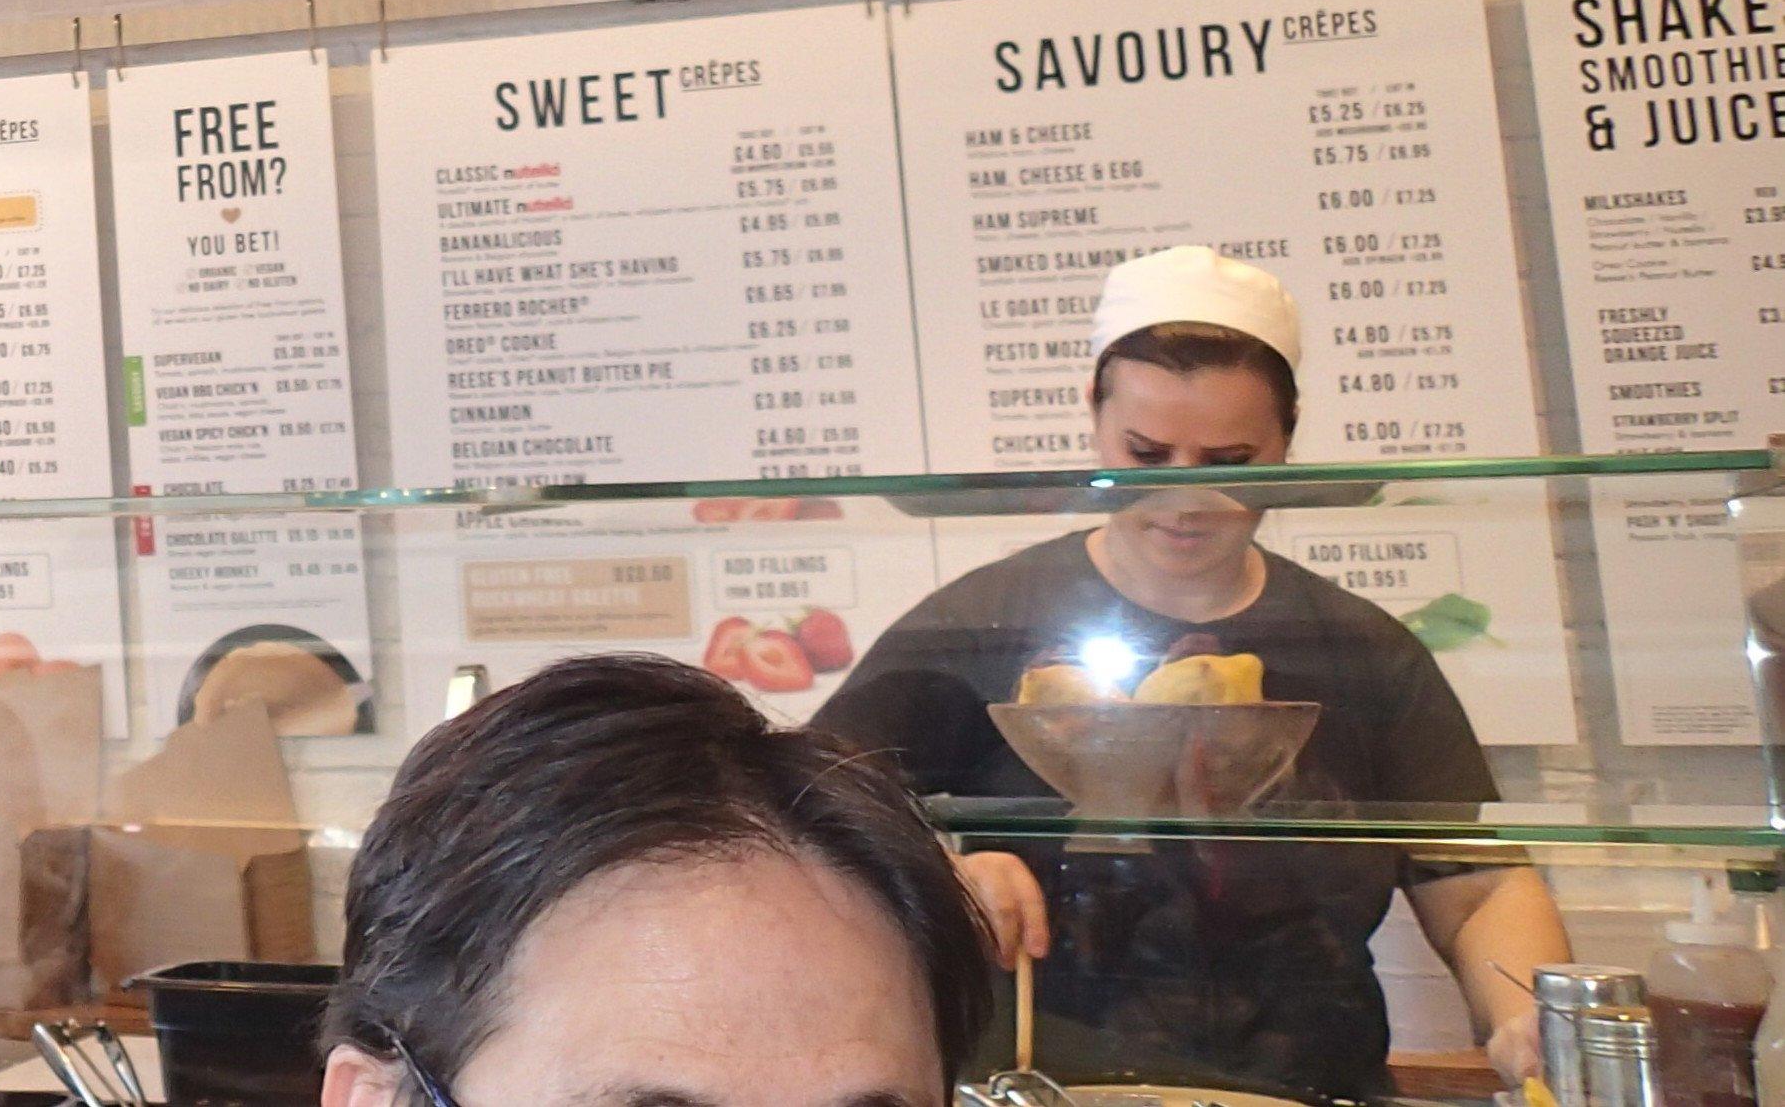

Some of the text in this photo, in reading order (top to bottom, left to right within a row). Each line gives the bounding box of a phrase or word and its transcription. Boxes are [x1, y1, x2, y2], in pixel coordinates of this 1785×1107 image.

[994, 8, 1378, 94] SAVOURY CRÊPES
[495, 60, 761, 132] SWEET CRÊPES
[1309, 102, 1364, 123] £5.25
[174, 100, 279, 158] FREE
[966, 129, 1002, 147] HAM
[1026, 122, 1093, 144] CHEESE
[1585, 104, 1616, 152] &
[1314, 144, 1369, 166] £5.75
[177, 157, 287, 203] FROM?
[436, 165, 498, 184] CLASSIC
[1019, 164, 1085, 185] CHEESE
[1109, 159, 1144, 180] EGG
[438, 199, 511, 219] ULTIMATE
[1319, 189, 1374, 210] £6.00
[1584, 190, 1687, 211] MILKSHAKES
[973, 207, 1100, 230] HAM SUPREME
[188, 231, 279, 256] YOU BET!
[440, 229, 562, 253] BANANALICIOUS
[1220, 239, 1291, 258] CHEESE
[1323, 233, 1379, 255] £6.00
[475, 267, 514, 285] HAVE
[520, 263, 563, 282] WHAT
[569, 260, 614, 280] SHE'S
[619, 257, 679, 275] HAVING
[977, 248, 1126, 274] SMOKED SALMON
[1329, 280, 1385, 300] £6.00
[444, 301, 511, 321] FERRERO
[980, 297, 1049, 319] LE GOAT
[1598, 306, 1668, 324] FRESHLY
[501, 334, 556, 352] COOKIE
[985, 342, 1040, 361] PESTO
[154, 351, 222, 367] SUPERVEGAN
[1604, 345, 1668, 364] ORANGE
[448, 371, 511, 389] REESE'S
[517, 366, 576, 385] PEANUT
[583, 363, 642, 384] BUTTER
[648, 362, 673, 380] PIE
[156, 385, 189, 400] VEGAN
[450, 404, 532, 424] CINNAMON
[159, 428, 192, 442] VEGAN
[1344, 421, 1401, 442] £6.00
[452, 436, 614, 459] BELGIAN CHOCOLATE
[992, 433, 1071, 455] CHICKEN
[1309, 543, 1428, 562] ADD FILLINGS
[759, 555, 828, 573] FILLINGS
